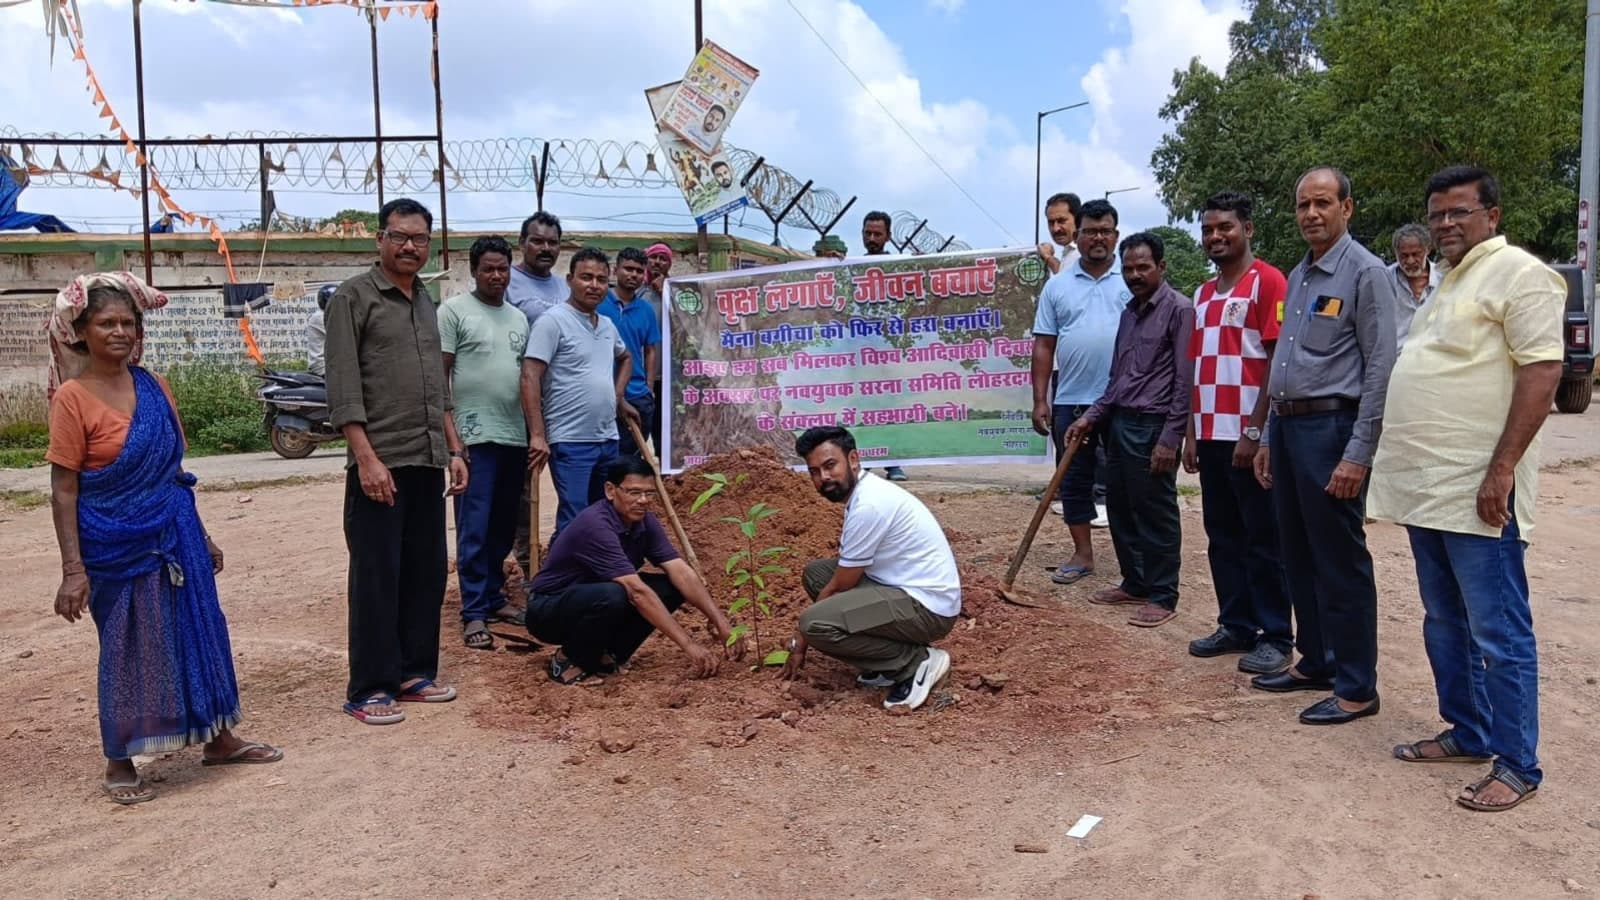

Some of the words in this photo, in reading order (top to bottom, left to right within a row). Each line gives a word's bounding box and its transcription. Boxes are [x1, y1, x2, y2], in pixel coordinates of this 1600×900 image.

[717, 287, 759, 325] वृक्ष
[765, 272, 847, 312] लगाएँ,
[852, 267, 924, 304] जीवन
[930, 257, 996, 297] बचाएँ
[189, 307, 207, 316] 2022
[720, 329, 755, 348] मैना
[760, 323, 814, 345] बगीचा
[820, 320, 844, 340] को
[851, 315, 883, 337] फिर
[888, 315, 904, 335] से
[910, 317, 937, 333] हरा
[683, 359, 729, 376] आइए
[731, 358, 757, 375] हम
[761, 356, 788, 373] सब
[793, 351, 856, 370] मिलकर
[861, 347, 900, 366] विश्व
[907, 341, 987, 362] आदिवासी
[682, 386, 699, 405] के
[759, 386, 781, 401] पर
[785, 381, 853, 403] नवयुवक
[859, 378, 903, 395] सरना
[908, 371, 961, 392] समिति
[968, 370, 1034, 390] लोहरदग
[757, 412, 775, 431] के
[842, 407, 857, 426] में
[862, 403, 927, 424] सहभागी
